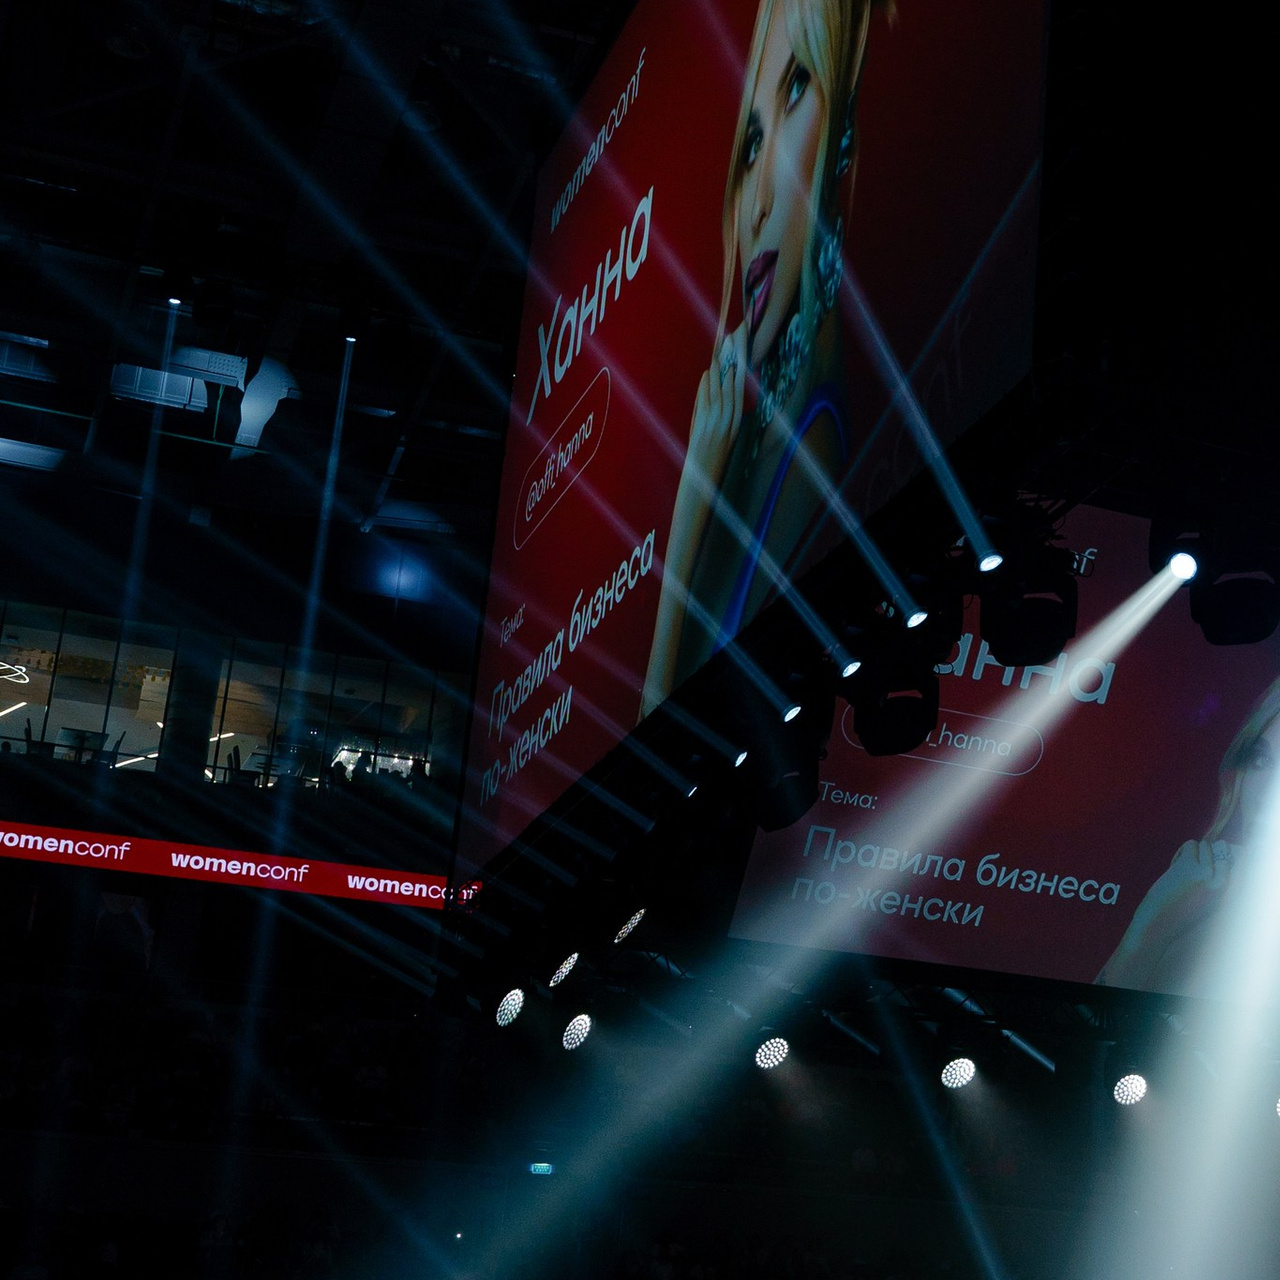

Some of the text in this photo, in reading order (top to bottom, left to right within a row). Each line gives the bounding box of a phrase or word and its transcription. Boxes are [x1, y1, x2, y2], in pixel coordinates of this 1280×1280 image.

[550, 46, 647, 233] womenconf
[526, 186, 654, 426] Ханна
[525, 411, 594, 522] @offi_hanna
[488, 528, 656, 743] Правила бизнеса
[480, 685, 573, 807] по-женски
[819, 781, 878, 810] Тема:
[171, 852, 309, 882] womenconf
[790, 877, 985, 928] по-женски
[803, 825, 1121, 905] Правила бизнеса
